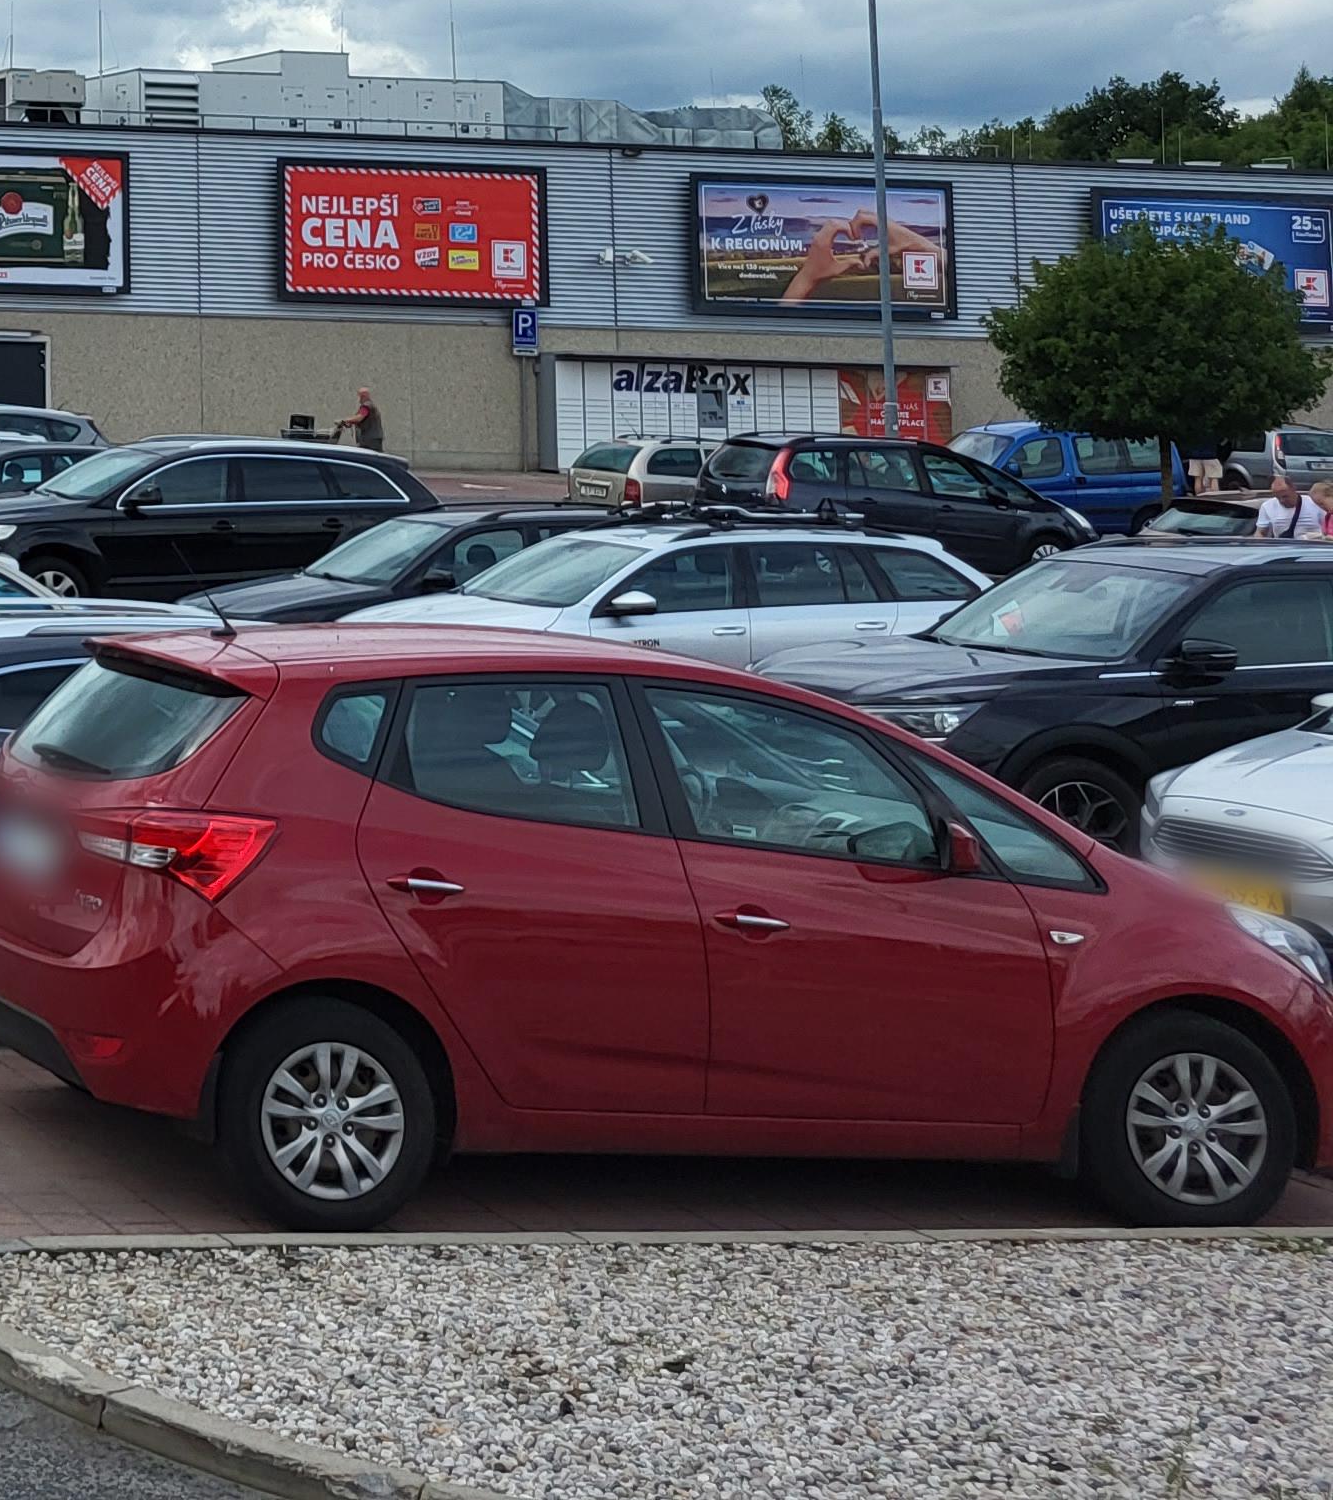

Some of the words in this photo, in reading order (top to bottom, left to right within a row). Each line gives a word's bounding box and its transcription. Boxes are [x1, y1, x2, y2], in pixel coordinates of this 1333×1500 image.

[301, 194, 399, 217] NEJLEPŠÍ
[731, 213, 747, 234] Z
[750, 211, 784, 236] lásky
[1174, 212, 1181, 221] S
[1184, 212, 1250, 225] KAFLAND
[1291, 215, 1312, 230] 25
[301, 217, 399, 249] CENA
[710, 237, 721, 250] K
[725, 235, 808, 252] REGIONŮM.
[301, 252, 339, 268] PRO
[343, 251, 400, 271] ČESKO
[518, 314, 532, 335] P
[613, 364, 751, 395] alzaBox
